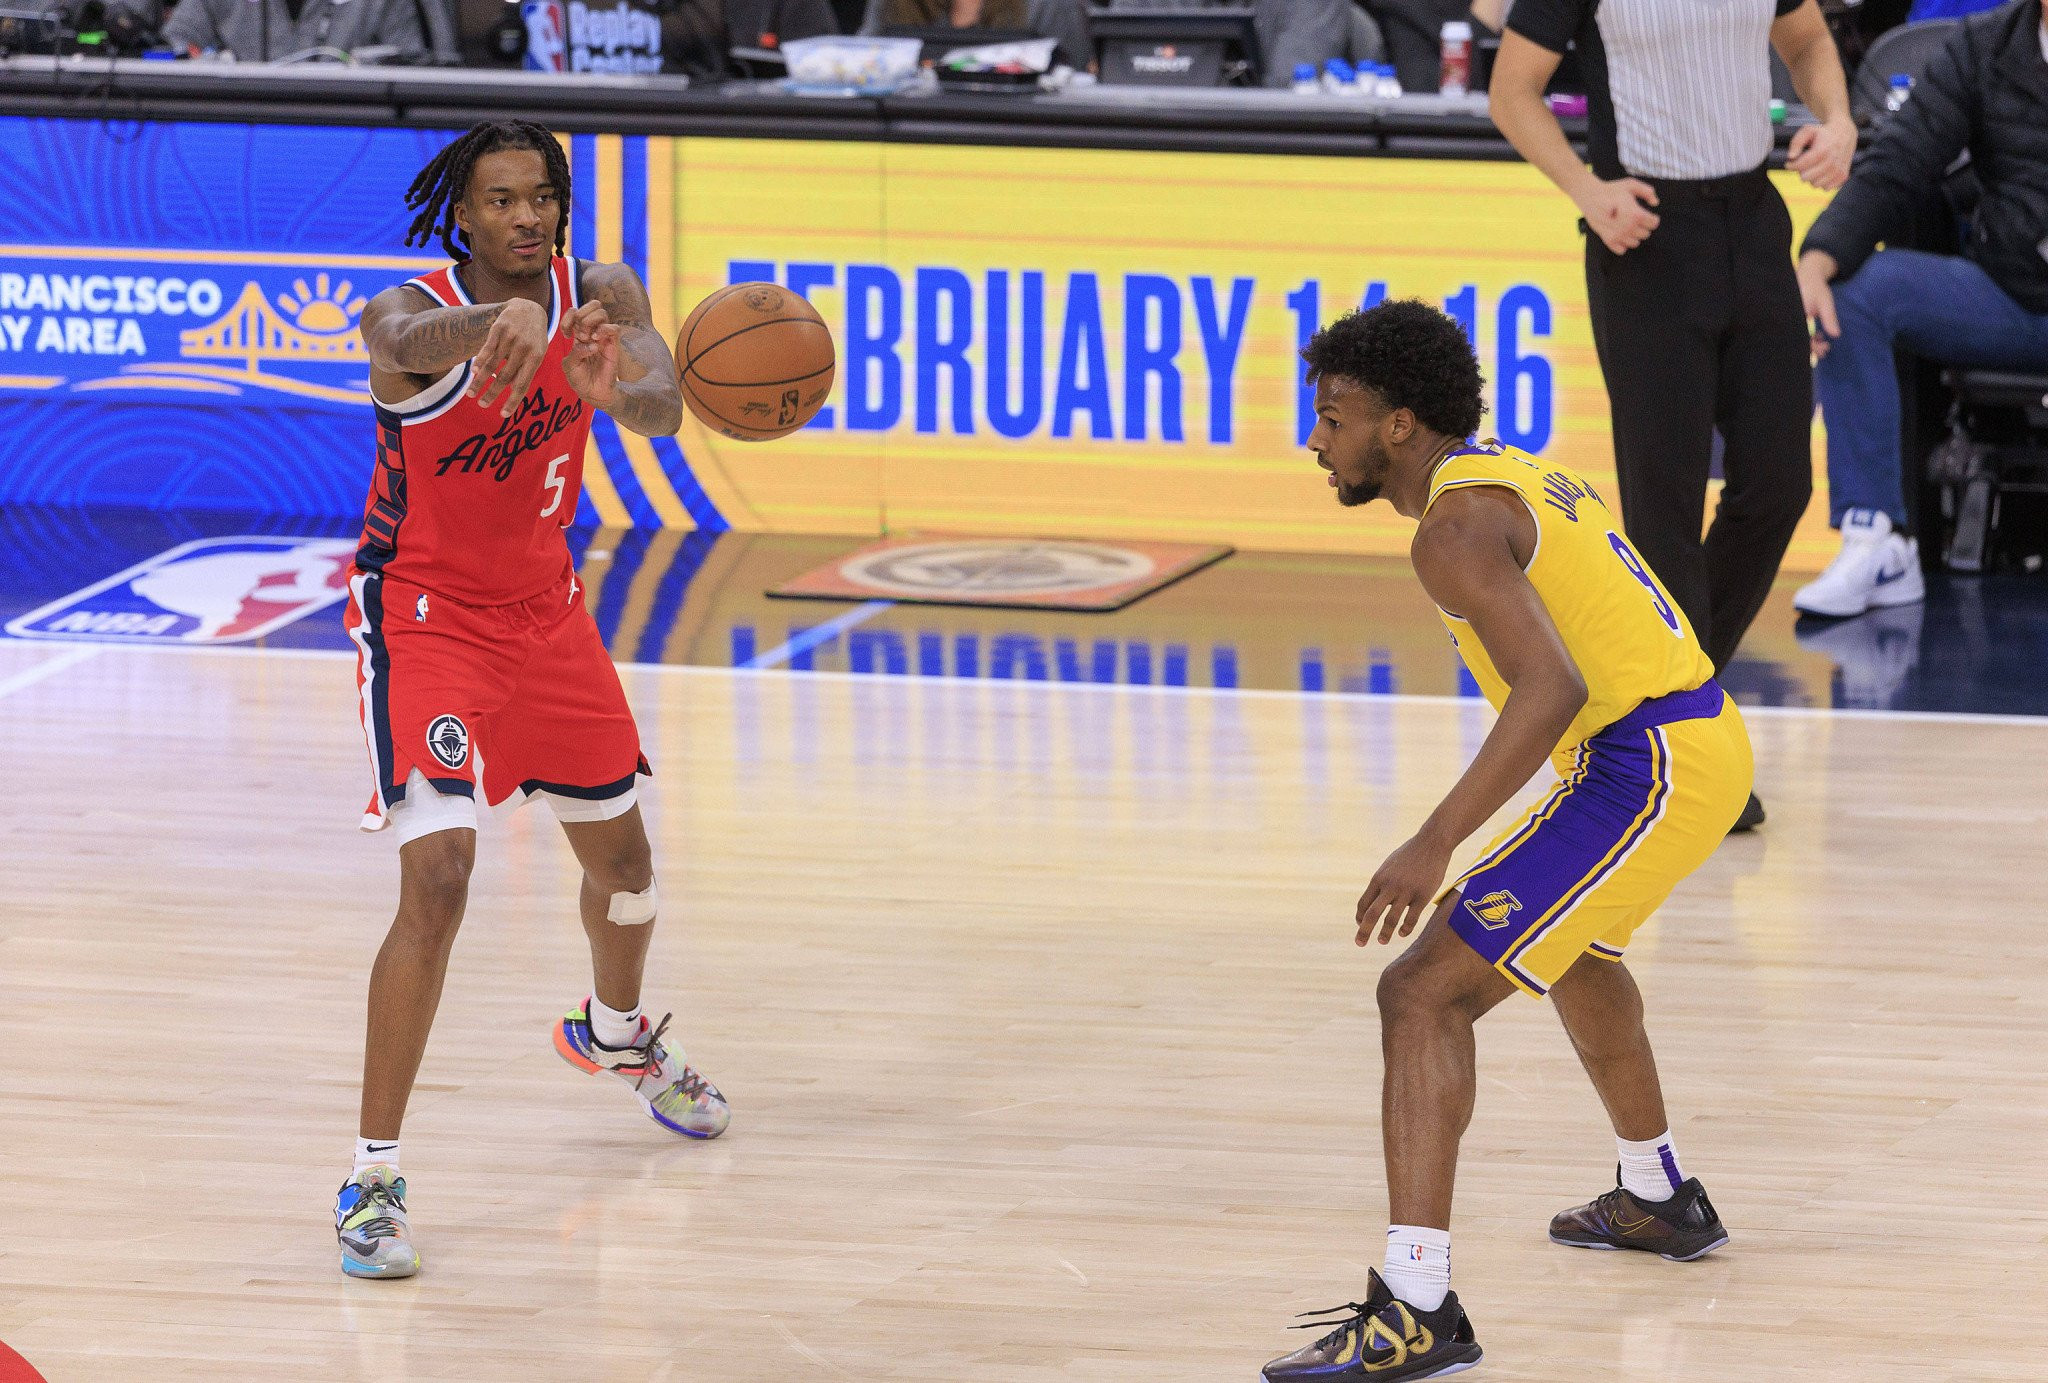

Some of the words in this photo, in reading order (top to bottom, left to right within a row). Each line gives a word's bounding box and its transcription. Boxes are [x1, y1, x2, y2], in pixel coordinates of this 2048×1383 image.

[0, 272, 223, 317] RANCISCO
[0, 315, 32, 352] Y
[36, 316, 147, 356] AREA
[726, 260, 1255, 446] BRUARY
[434, 397, 583, 482] Angeles
[539, 453, 570, 518] 5
[1605, 529, 1685, 639] 9
